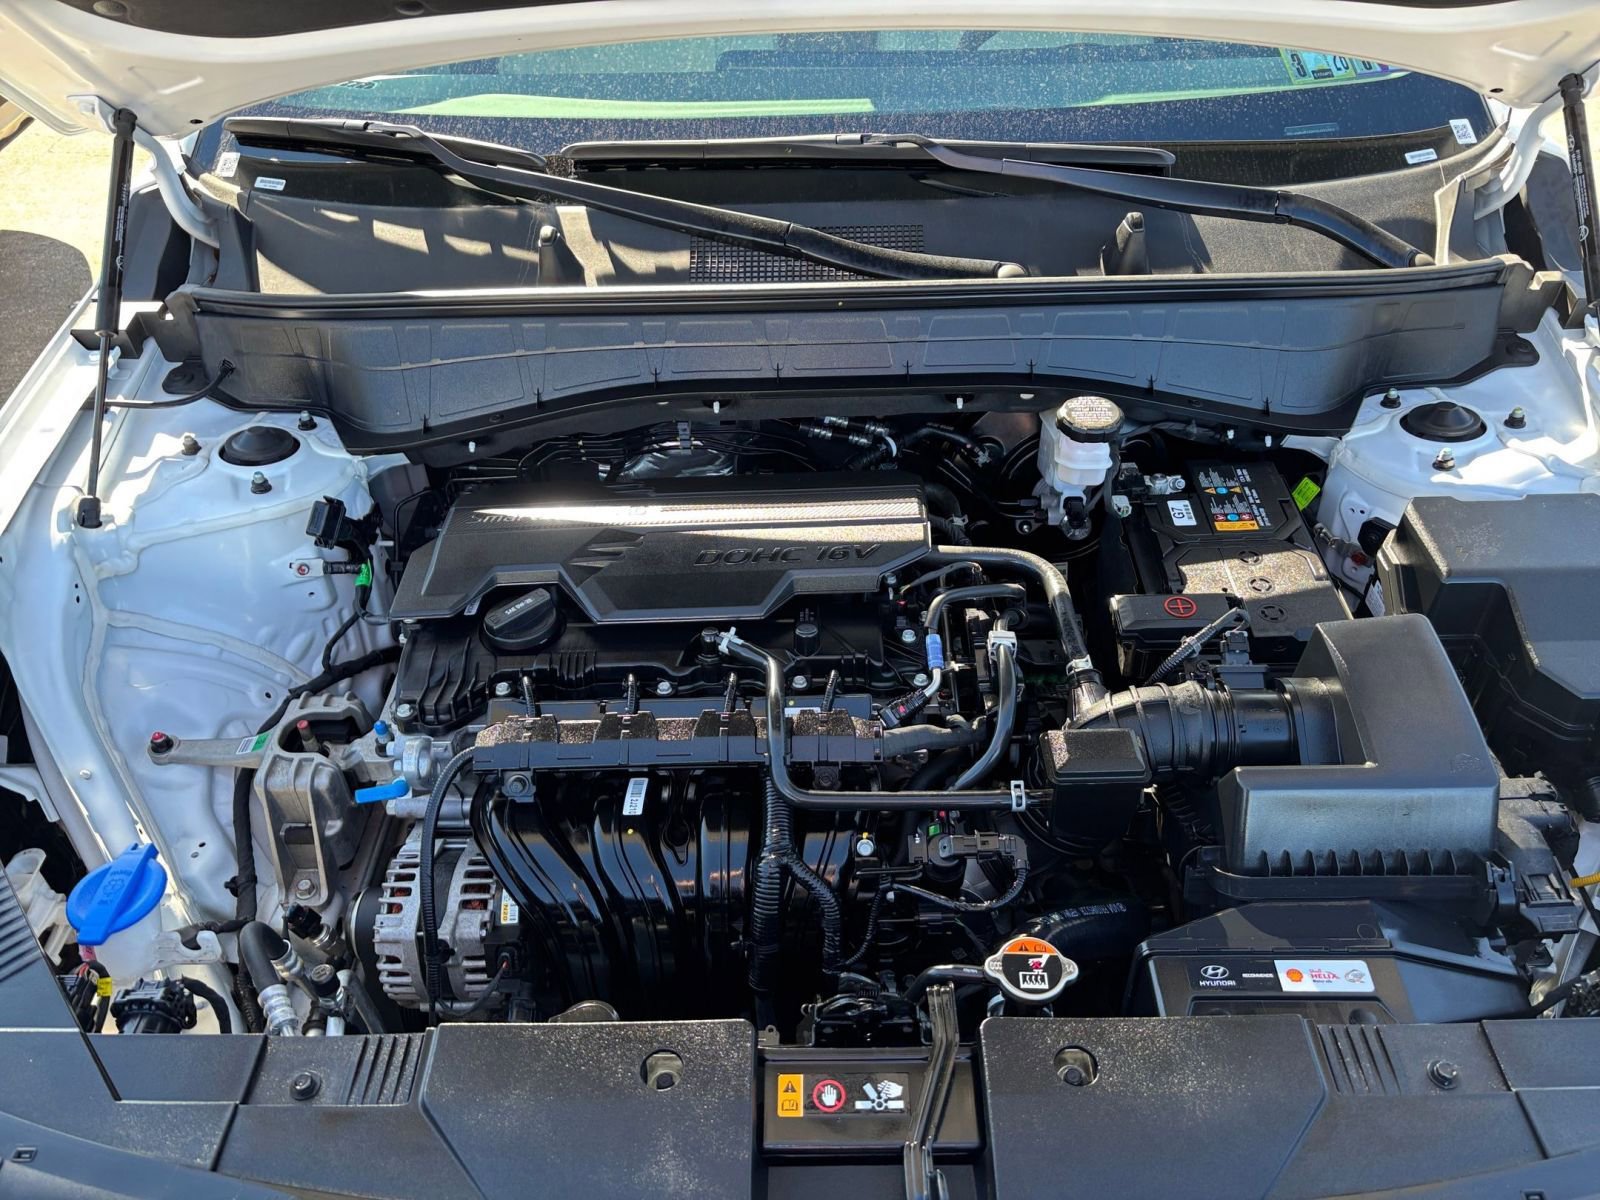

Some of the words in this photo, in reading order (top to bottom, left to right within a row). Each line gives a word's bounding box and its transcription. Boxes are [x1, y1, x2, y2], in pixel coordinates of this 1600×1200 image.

[1291, 54, 1306, 77] 3
[1171, 507, 1185, 519] G7
[693, 546, 808, 566] DOHC
[815, 543, 881, 562] 16V
